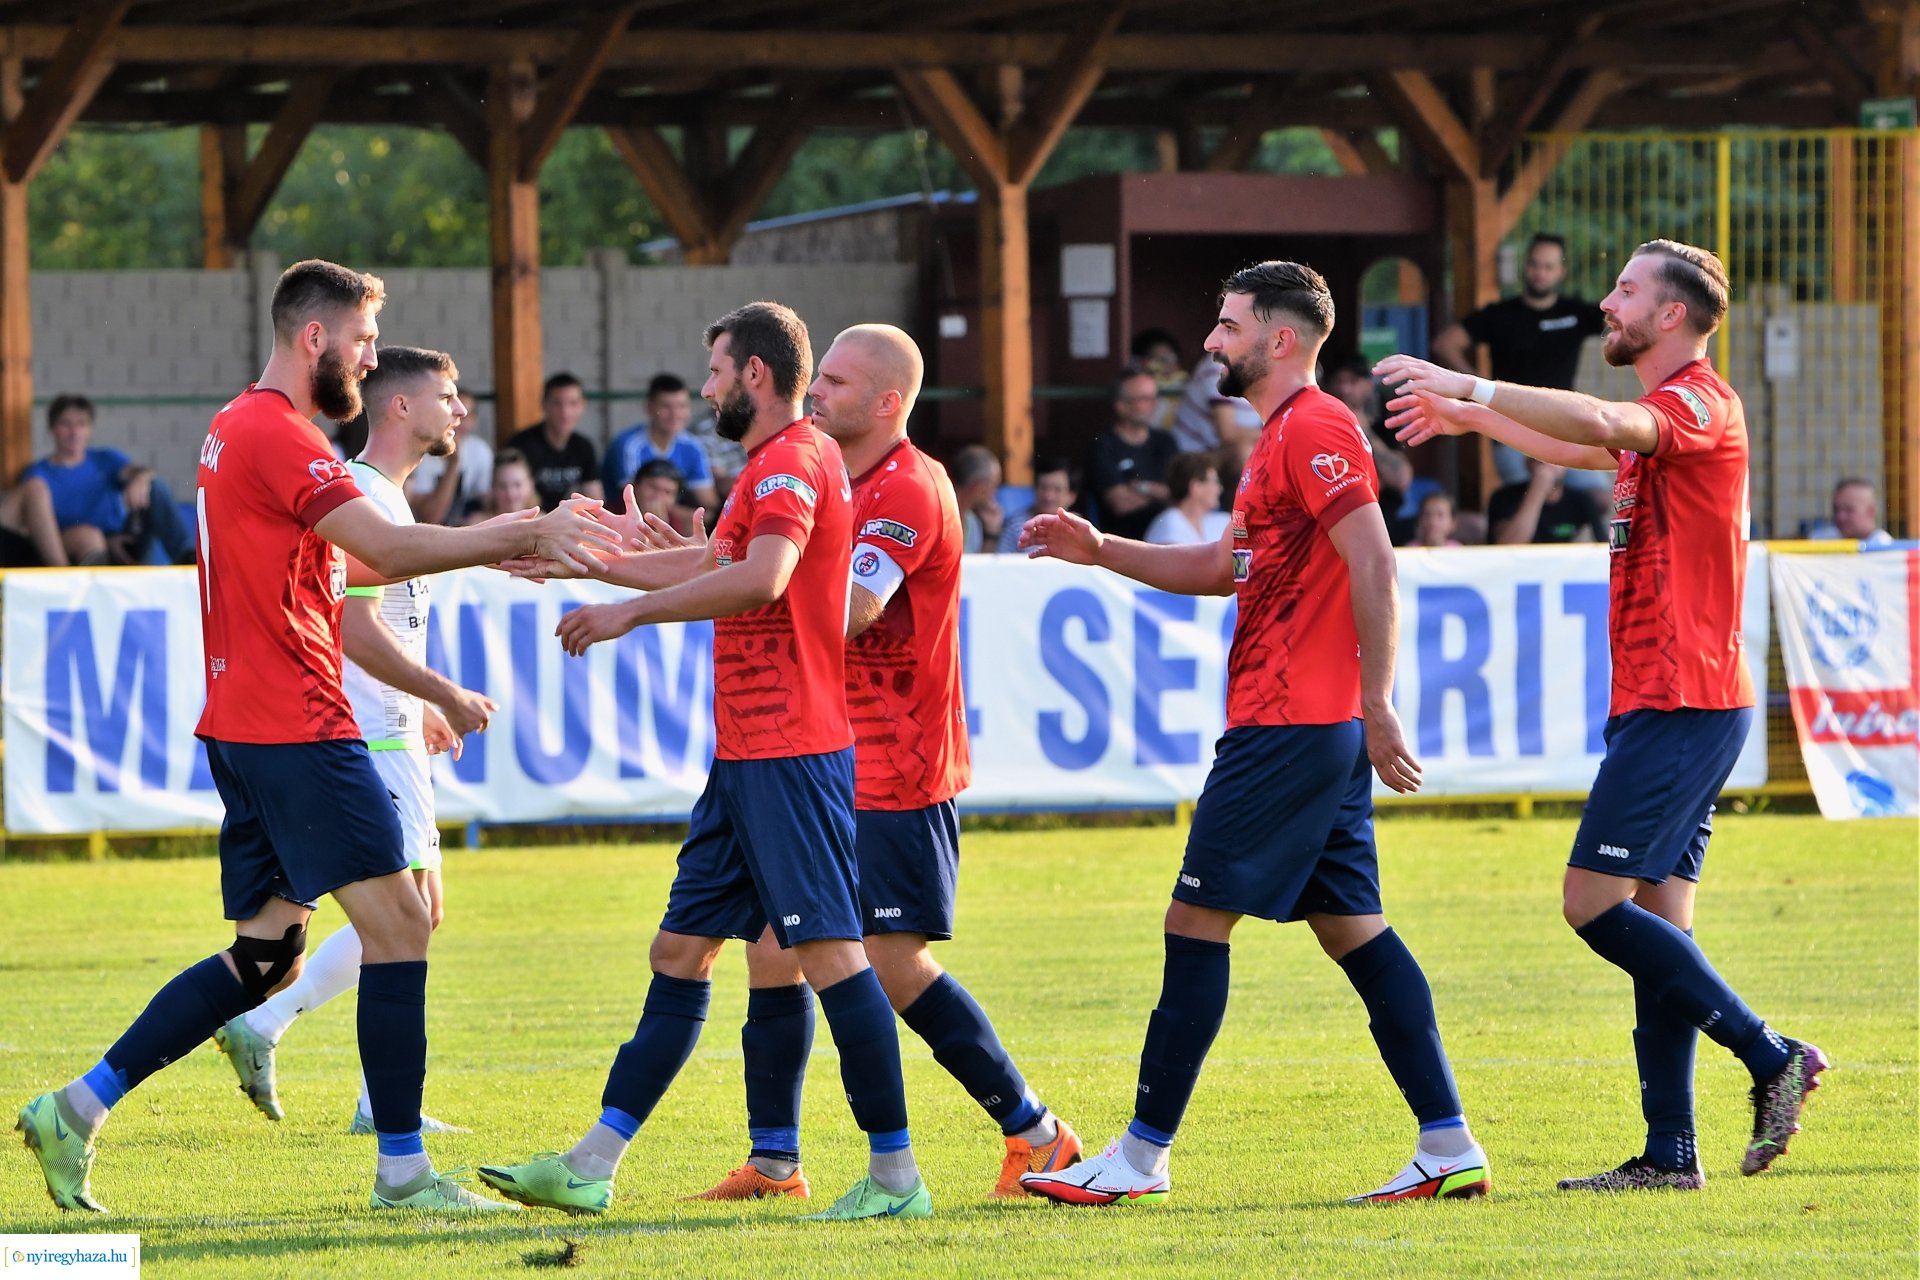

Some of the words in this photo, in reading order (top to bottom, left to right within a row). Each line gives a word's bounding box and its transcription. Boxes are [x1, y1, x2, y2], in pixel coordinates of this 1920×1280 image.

[46, 602, 717, 792] MNUM
[1038, 583, 1611, 772] SERIT
[1597, 843, 1630, 859] JAKO
[783, 914, 801, 927] AKO
[873, 907, 902, 919] JAKO
[1700, 1010, 1722, 1031] AKO
